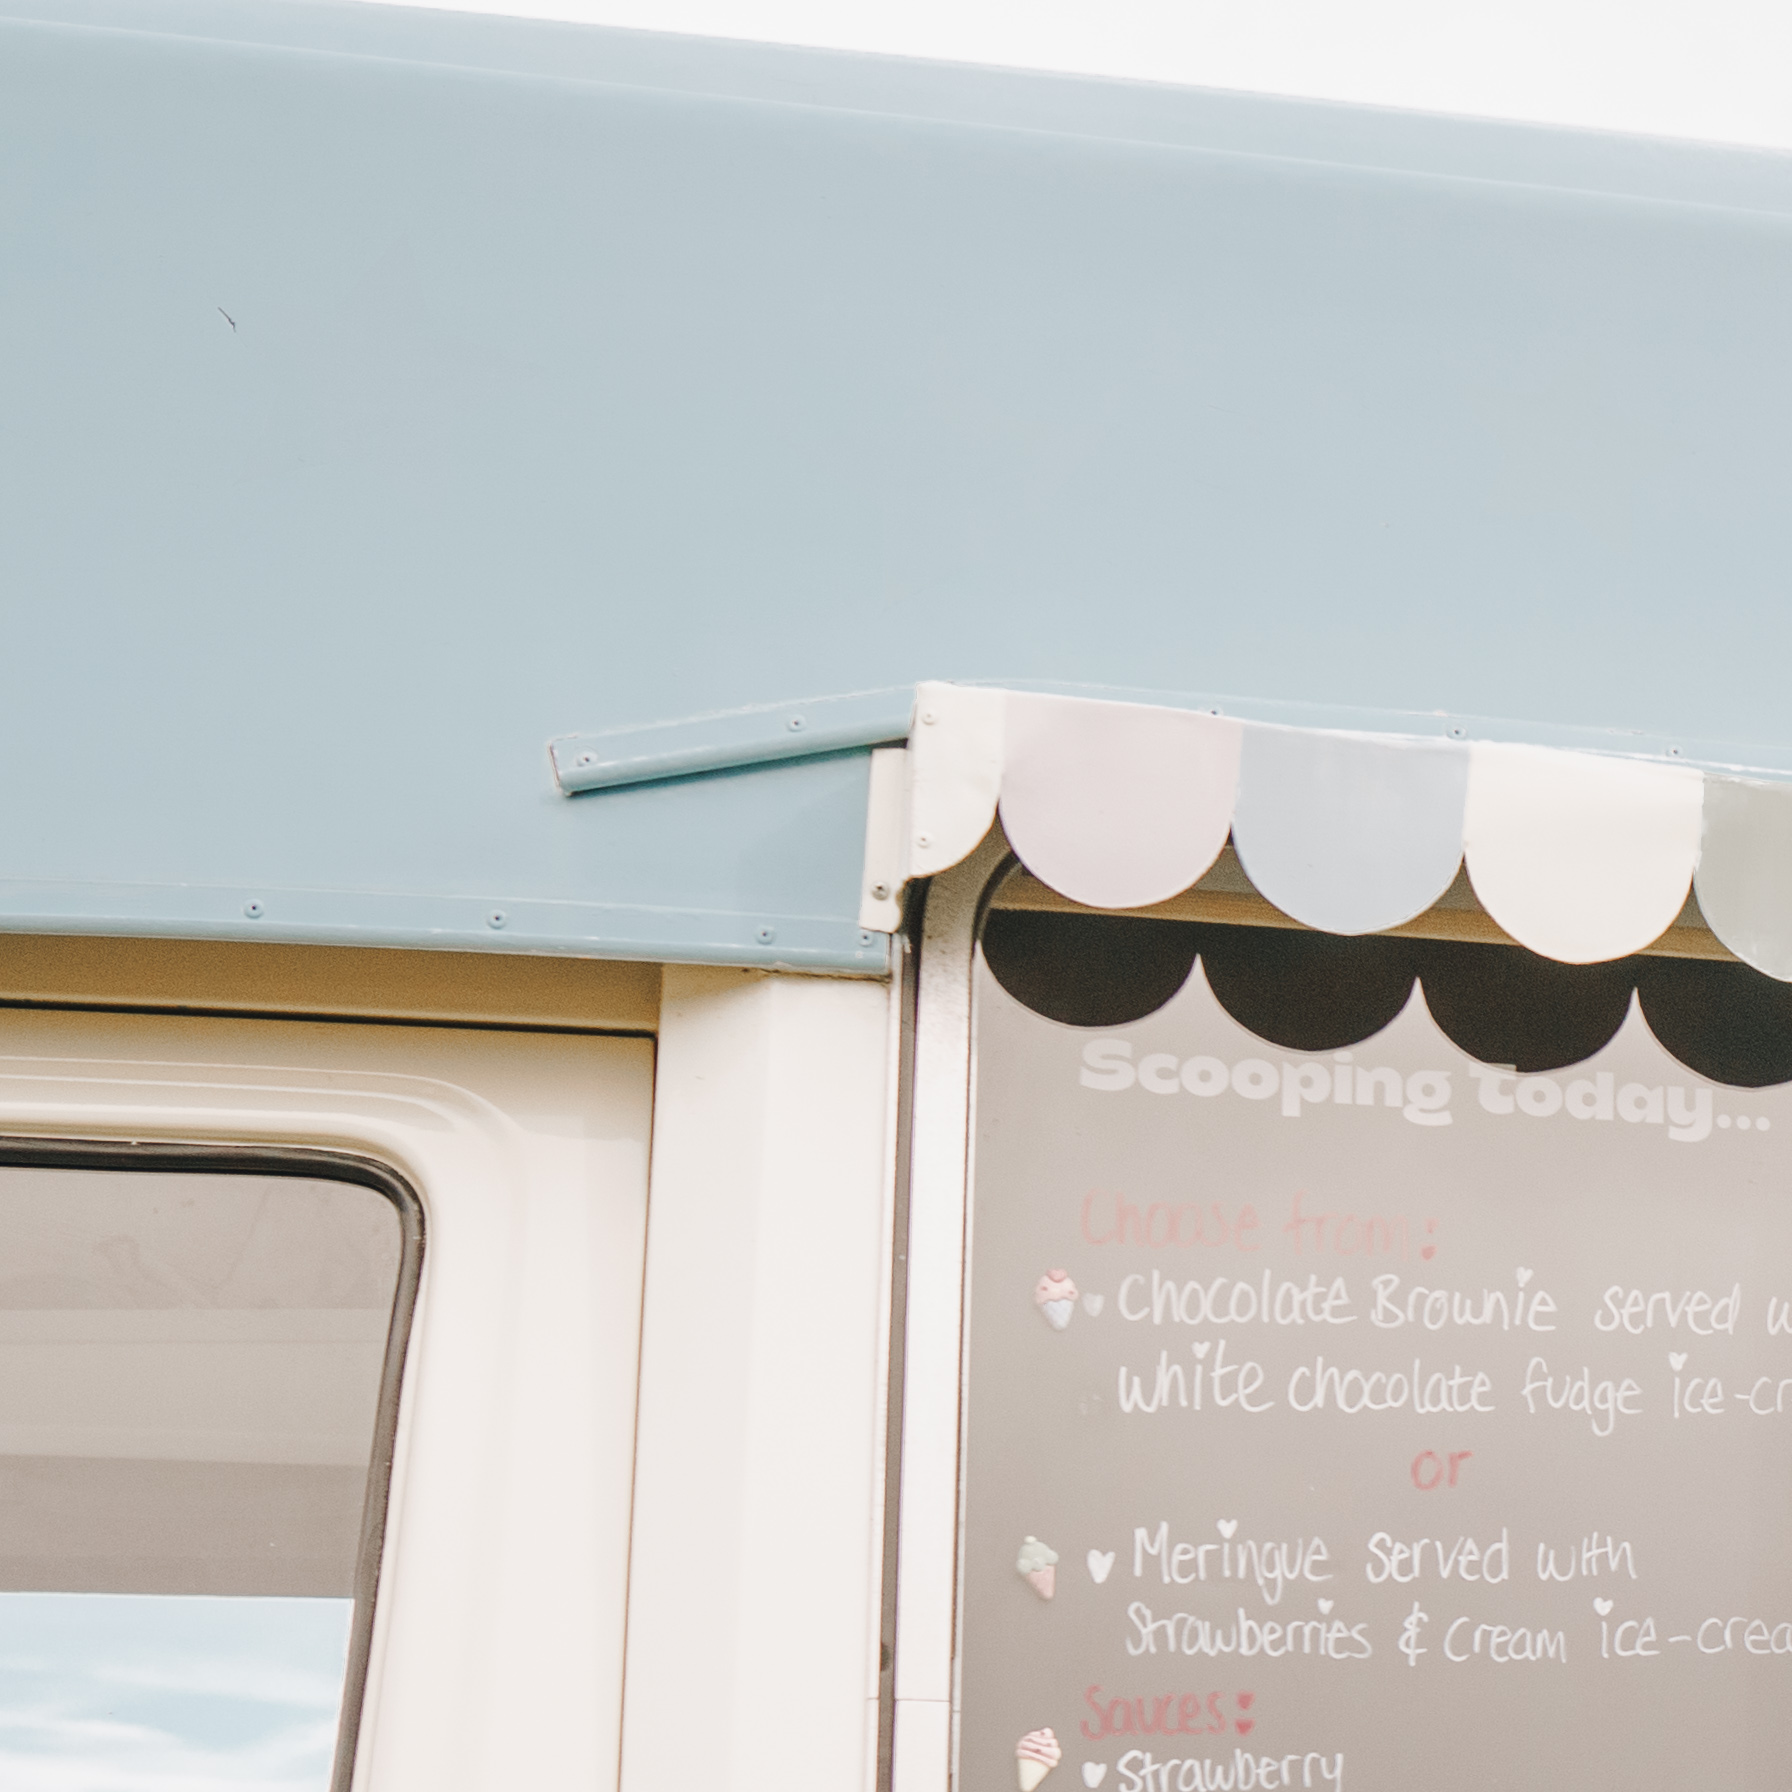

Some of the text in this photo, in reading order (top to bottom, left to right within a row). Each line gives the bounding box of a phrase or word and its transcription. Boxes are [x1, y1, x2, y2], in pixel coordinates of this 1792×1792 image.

[1079, 1037, 1772, 1143] Scooping today...
[1081, 1187, 1261, 1252] Choose
[1117, 1268, 1358, 1325] Chocolate
[1370, 1265, 1558, 1332] Brownie
[1117, 1338, 1276, 1414] white
[1520, 1356, 1644, 1437] fudge
[1410, 1449, 1475, 1491] or
[1133, 1517, 1335, 1606] Meringue
[1537, 1531, 1638, 1582] with
[1125, 1597, 1373, 1661] Strawberries
[1398, 1600, 1429, 1667] &
